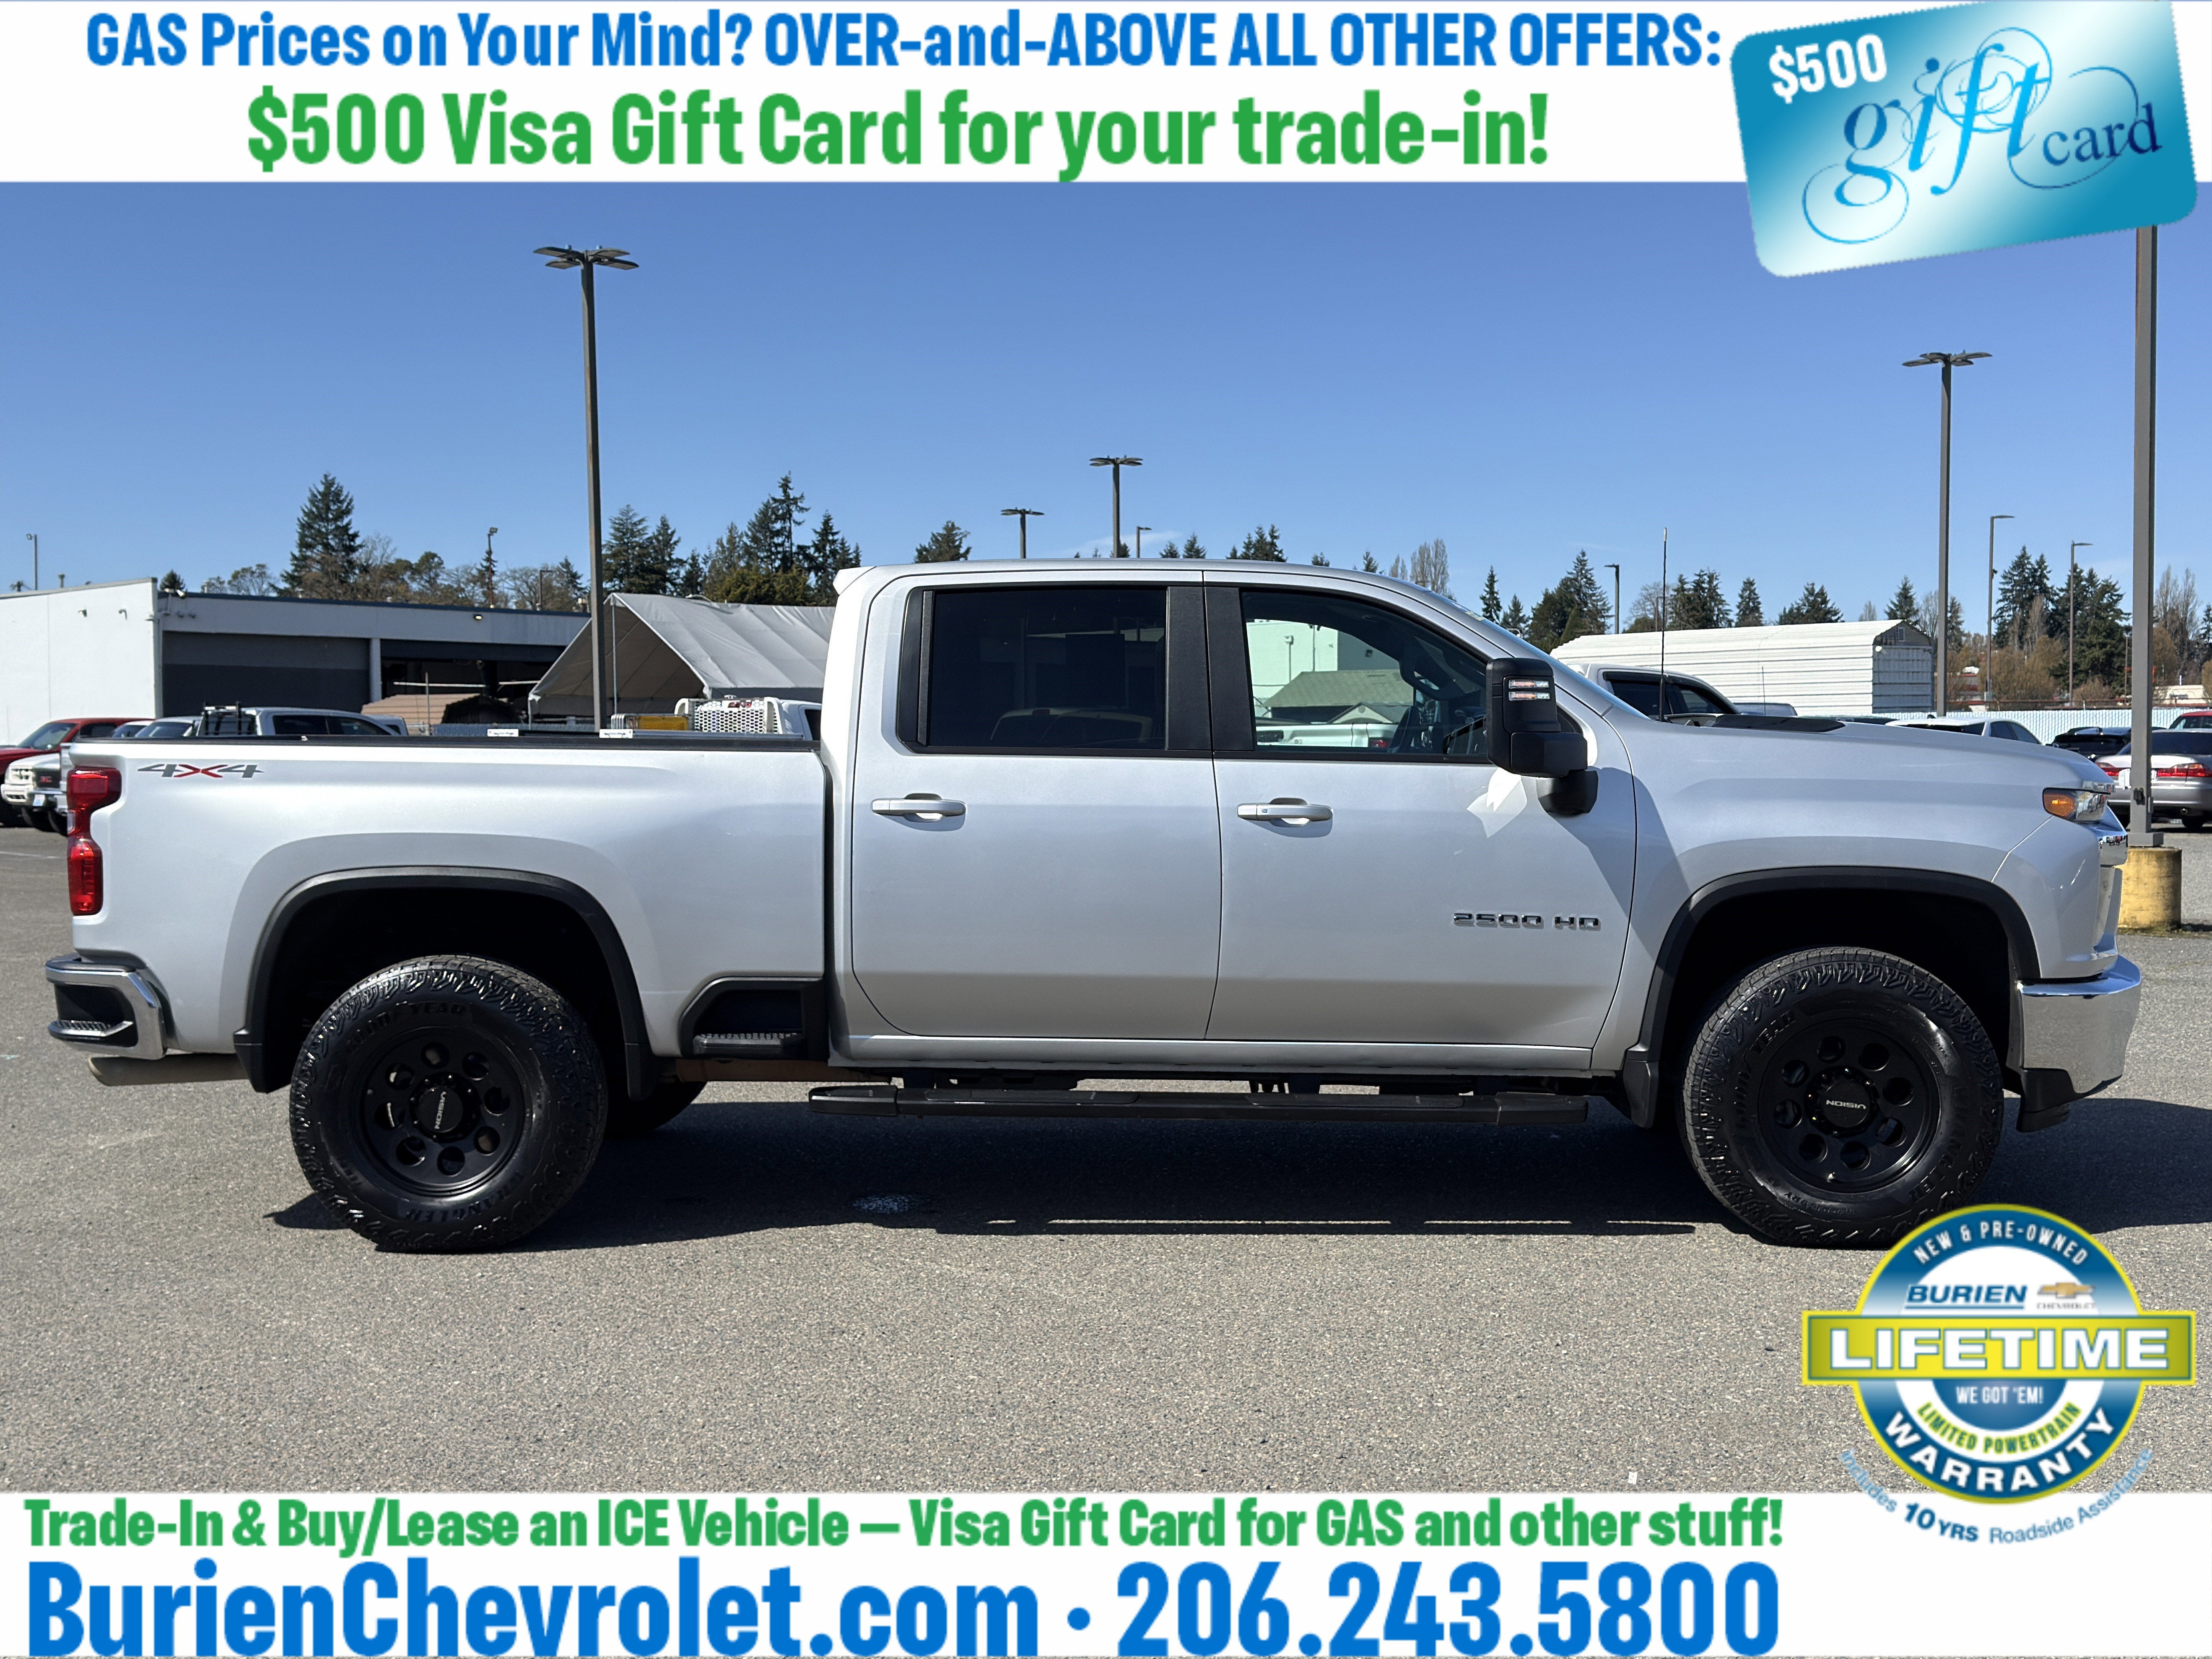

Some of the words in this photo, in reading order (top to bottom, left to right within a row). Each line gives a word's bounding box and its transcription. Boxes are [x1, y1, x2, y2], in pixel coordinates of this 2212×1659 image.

[1453, 912, 1543, 928] 2500
[1554, 916, 1600, 931] HD
[1826, 1100, 1867, 1110] VISION
